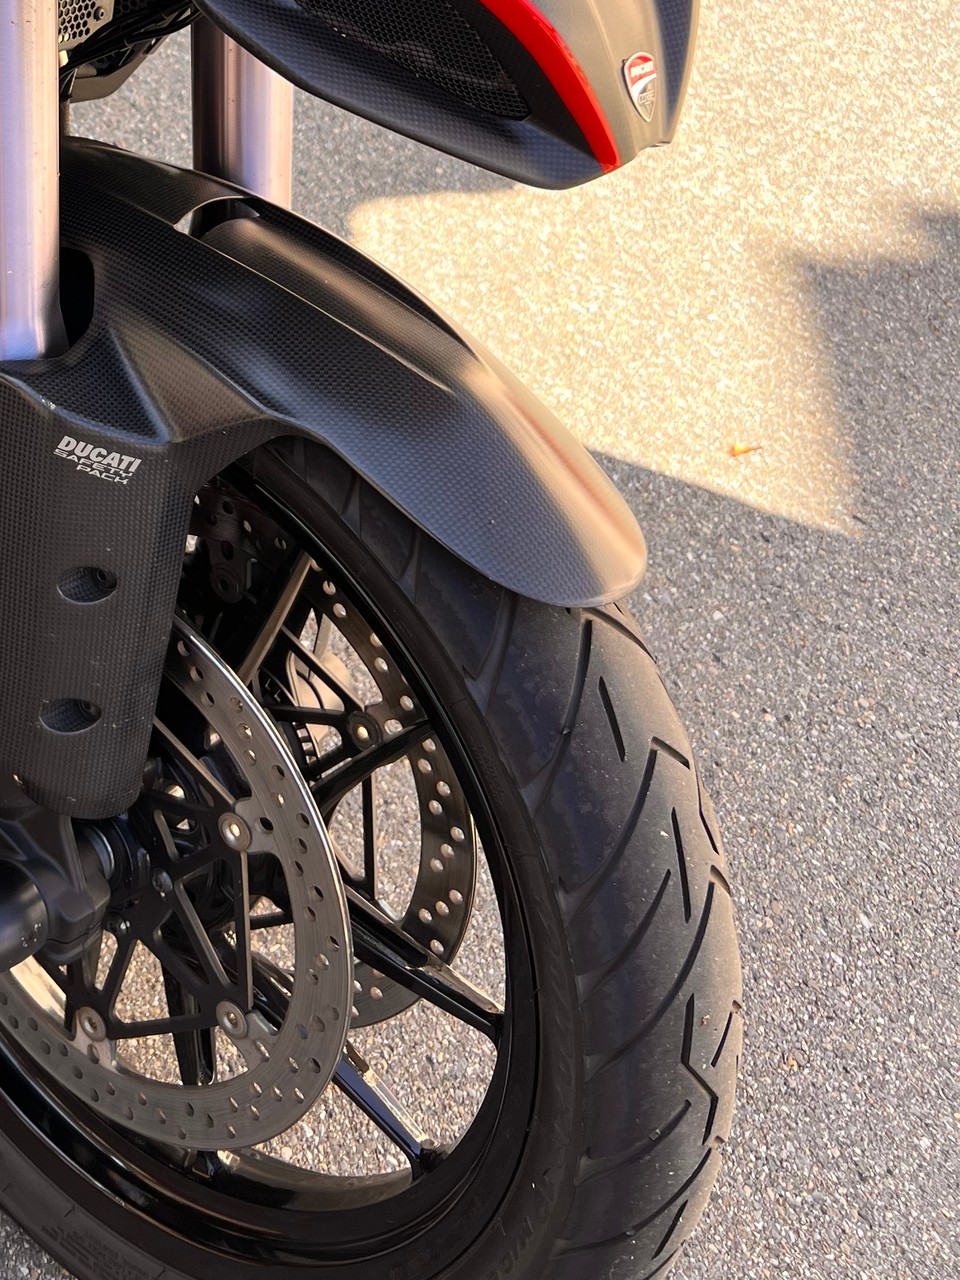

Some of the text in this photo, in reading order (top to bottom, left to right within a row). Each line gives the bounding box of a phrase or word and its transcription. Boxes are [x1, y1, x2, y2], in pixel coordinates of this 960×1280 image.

[53, 448, 133, 478] SAFETY
[57, 435, 143, 473] DUCATI
[76, 464, 130, 485] PACK
